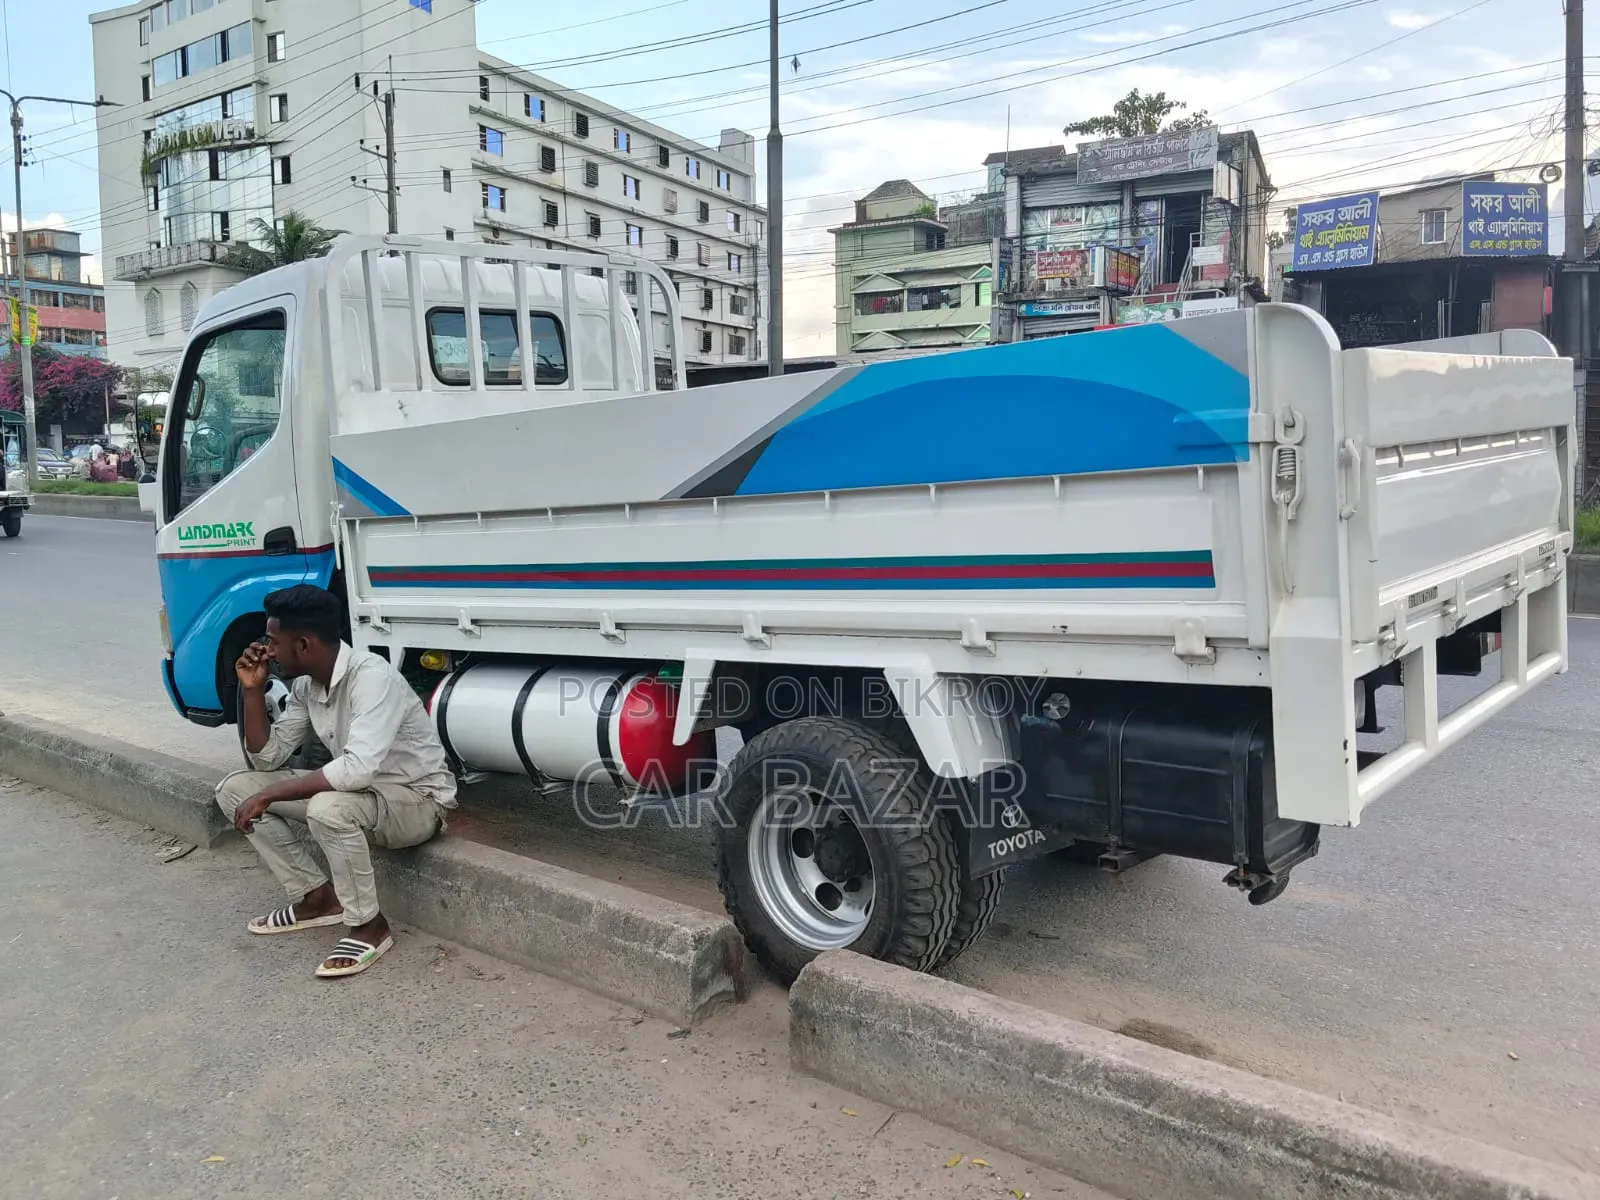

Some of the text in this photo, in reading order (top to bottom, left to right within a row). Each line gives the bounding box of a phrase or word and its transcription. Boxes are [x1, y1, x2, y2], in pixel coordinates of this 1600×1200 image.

[185, 119, 247, 146] TOWER
[1469, 187, 1541, 214] সফর আলী
[1302, 197, 1372, 227] সফর আলী
[1468, 217, 1485, 235] থাই
[1300, 229, 1314, 248] থাই
[1350, 243, 1369, 260] হাউস
[178, 521, 255, 541] LANDMARK
[227, 538, 256, 547] PRINT
[987, 829, 1047, 859] TOYOTA
